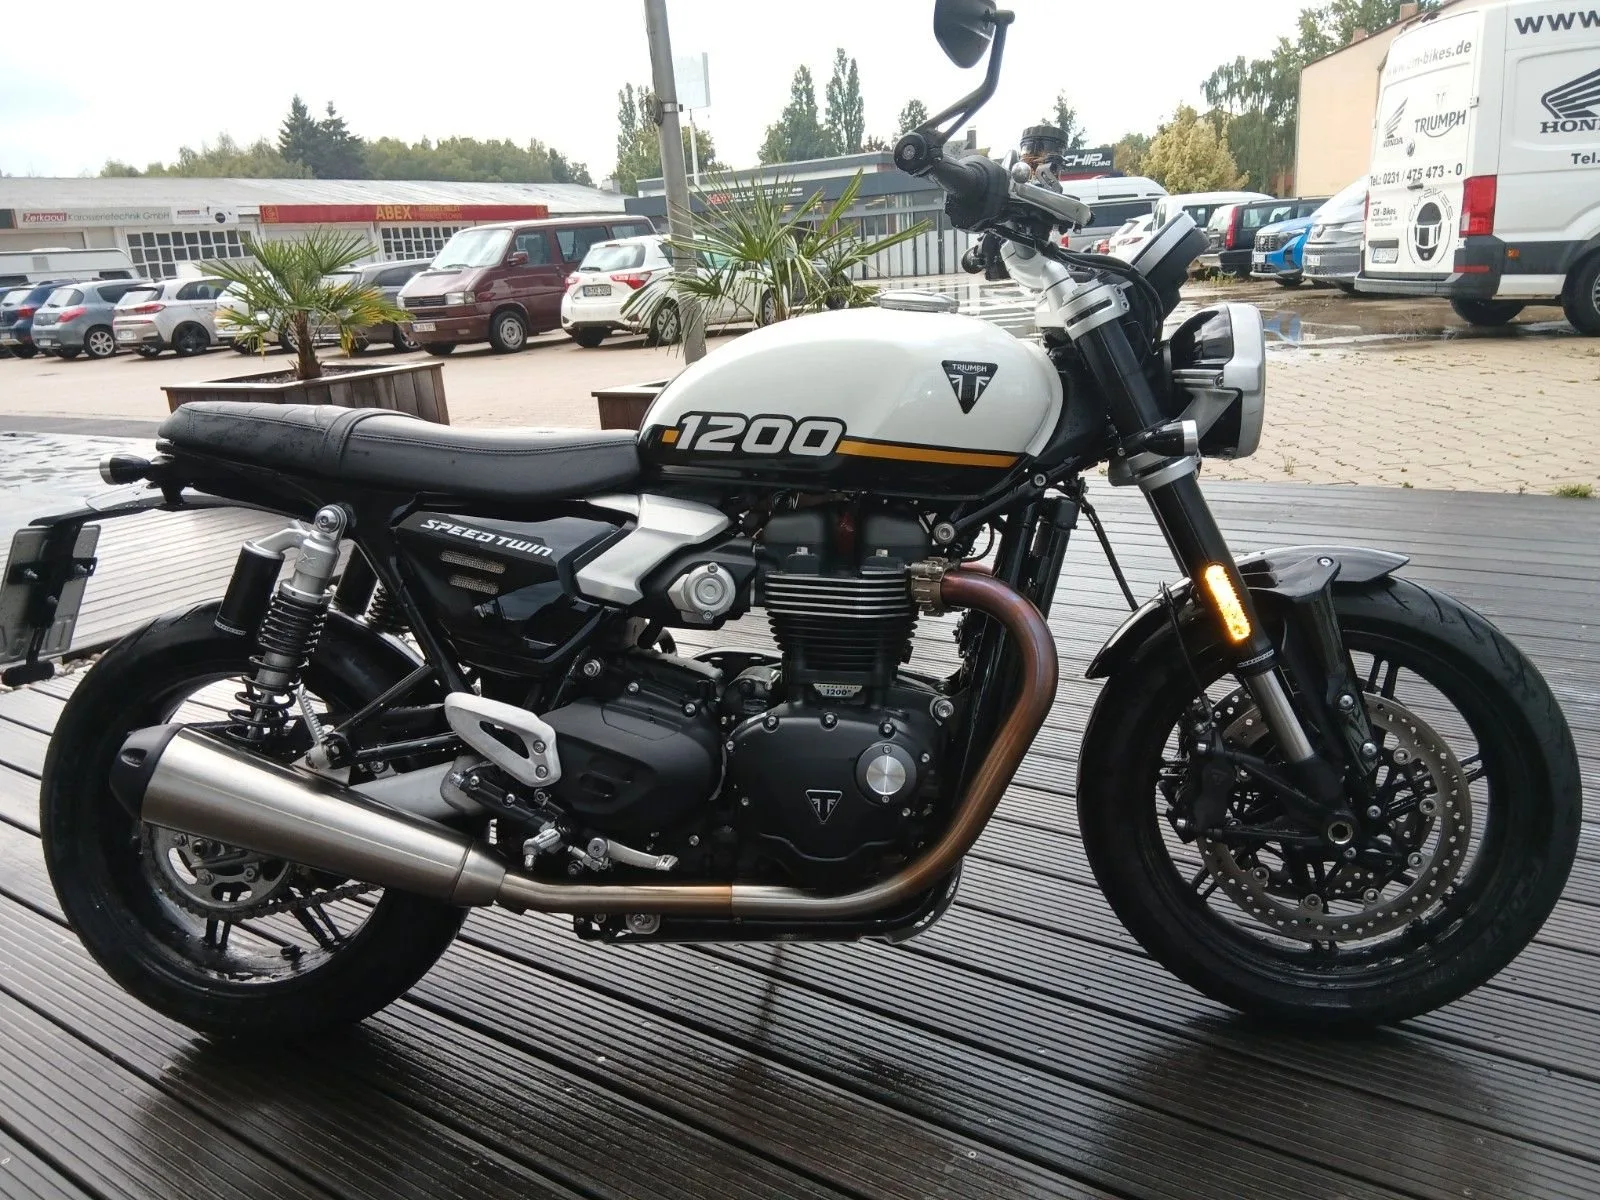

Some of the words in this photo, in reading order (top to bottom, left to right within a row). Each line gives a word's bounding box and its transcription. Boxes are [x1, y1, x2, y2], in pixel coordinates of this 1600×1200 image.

[1414, 109, 1467, 134] TRIUMPH
[1540, 118, 1600, 134] HON
[1382, 171, 1400, 185] 0231
[1406, 167, 1423, 183] 475
[1425, 164, 1444, 179] 473
[1455, 162, 1463, 176] 0
[142, 211, 170, 220] GmbH
[375, 205, 412, 220] ABEX
[952, 363, 987, 373] TRIUMPH
[675, 414, 844, 457] 1200
[420, 519, 496, 543] SPEED
[495, 535, 554, 557] TWIN
